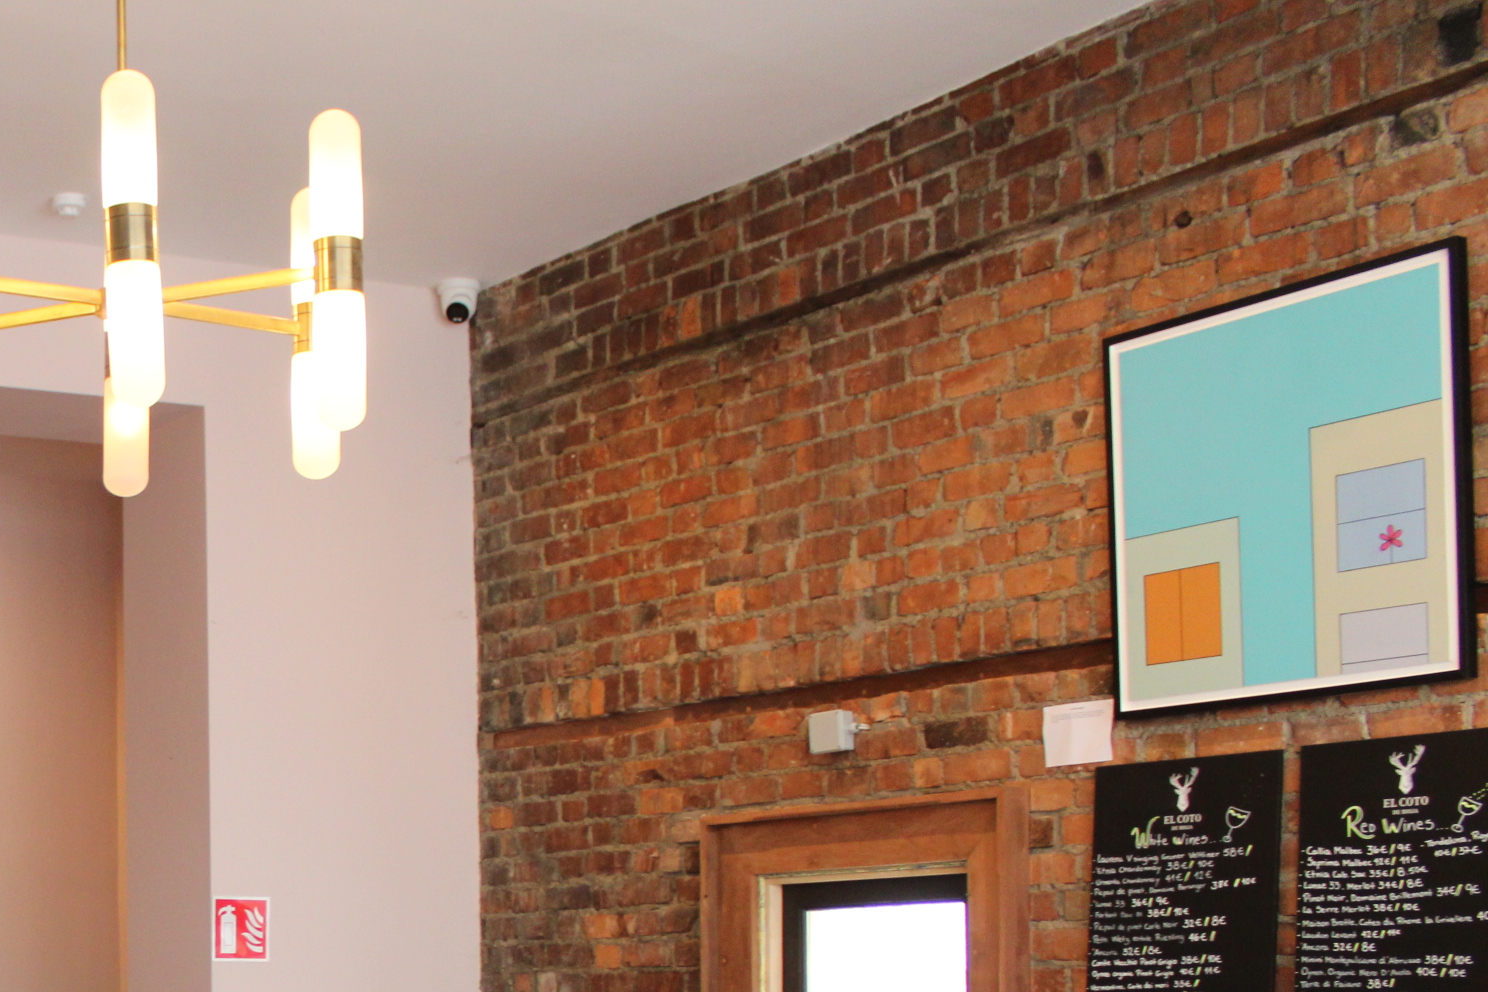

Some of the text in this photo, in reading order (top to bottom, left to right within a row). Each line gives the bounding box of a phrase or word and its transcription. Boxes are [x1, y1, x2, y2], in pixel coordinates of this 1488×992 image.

[1383, 796, 1430, 808] EL COTO
[1164, 814, 1202, 825] EL COTO
[1130, 816, 1169, 849] White
